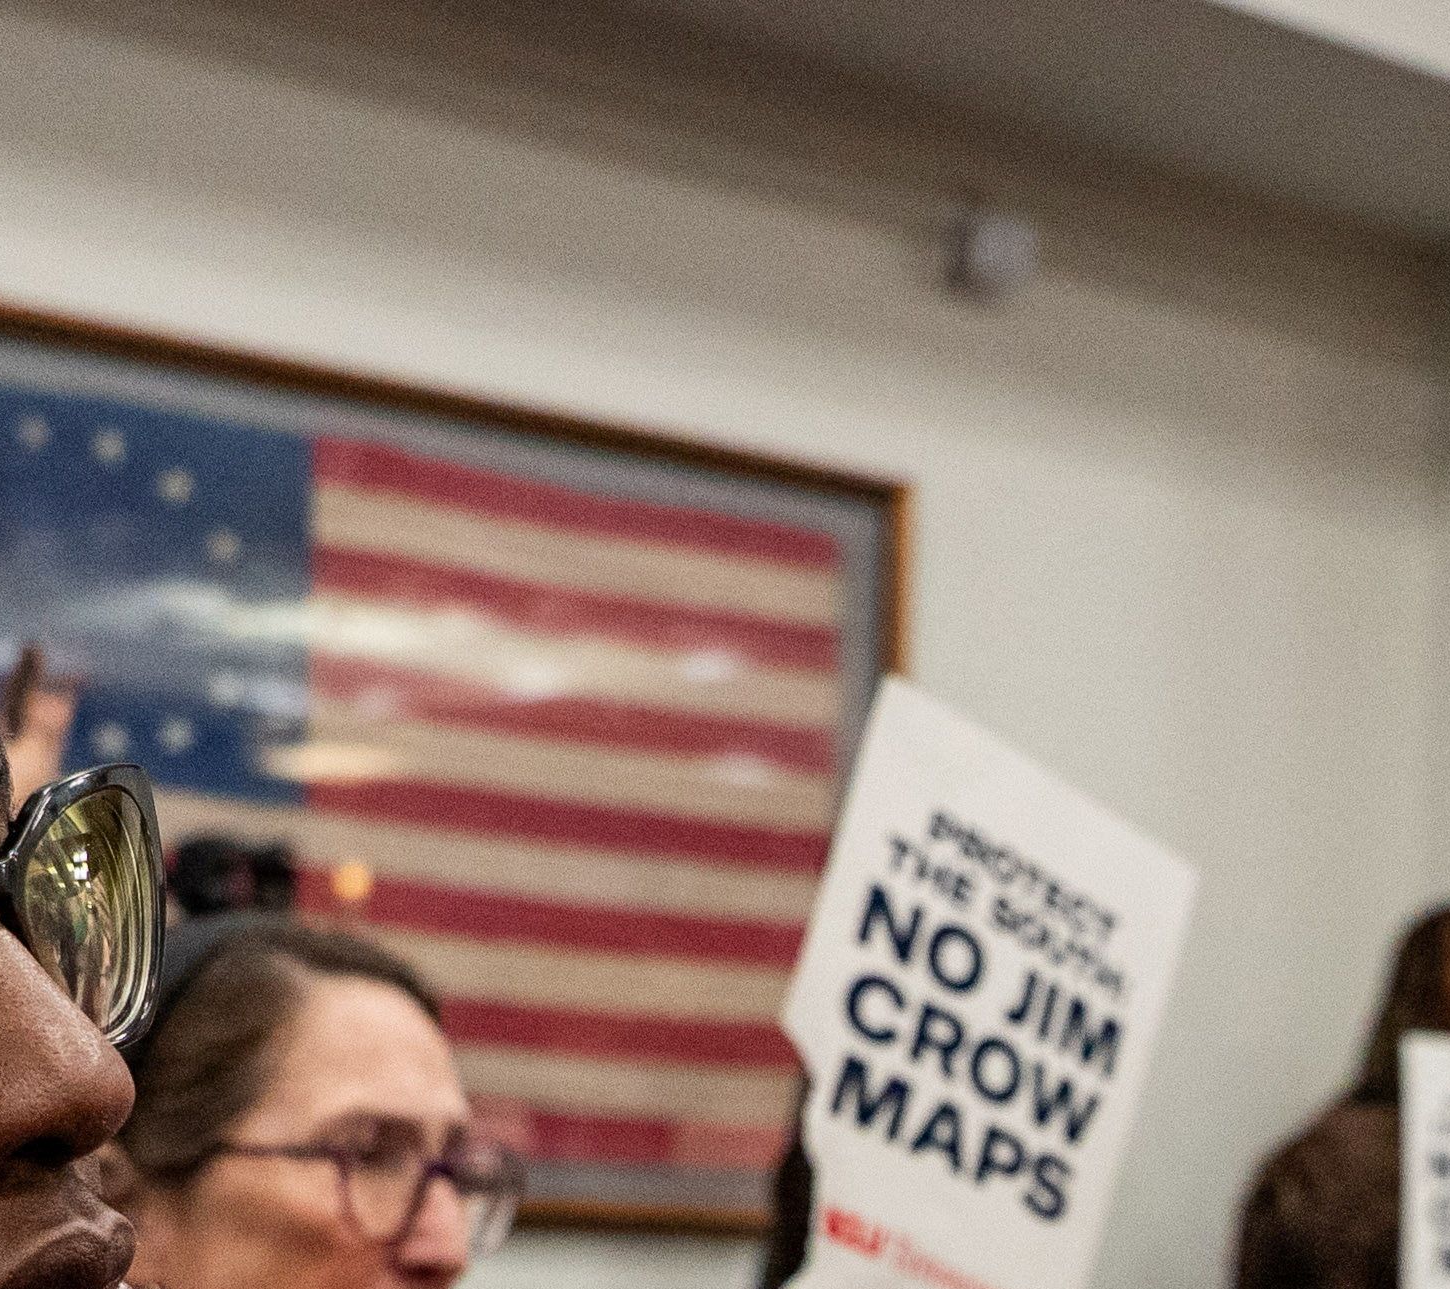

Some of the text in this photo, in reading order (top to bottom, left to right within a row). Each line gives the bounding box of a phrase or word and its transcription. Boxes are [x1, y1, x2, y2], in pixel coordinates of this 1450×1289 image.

[887, 832, 974, 908] THE
[927, 810, 1120, 940] PROTECT
[842, 971, 1103, 1150] CROW
[853, 879, 1125, 1080] NO JIM
[827, 1050, 1074, 1225] MAPS
